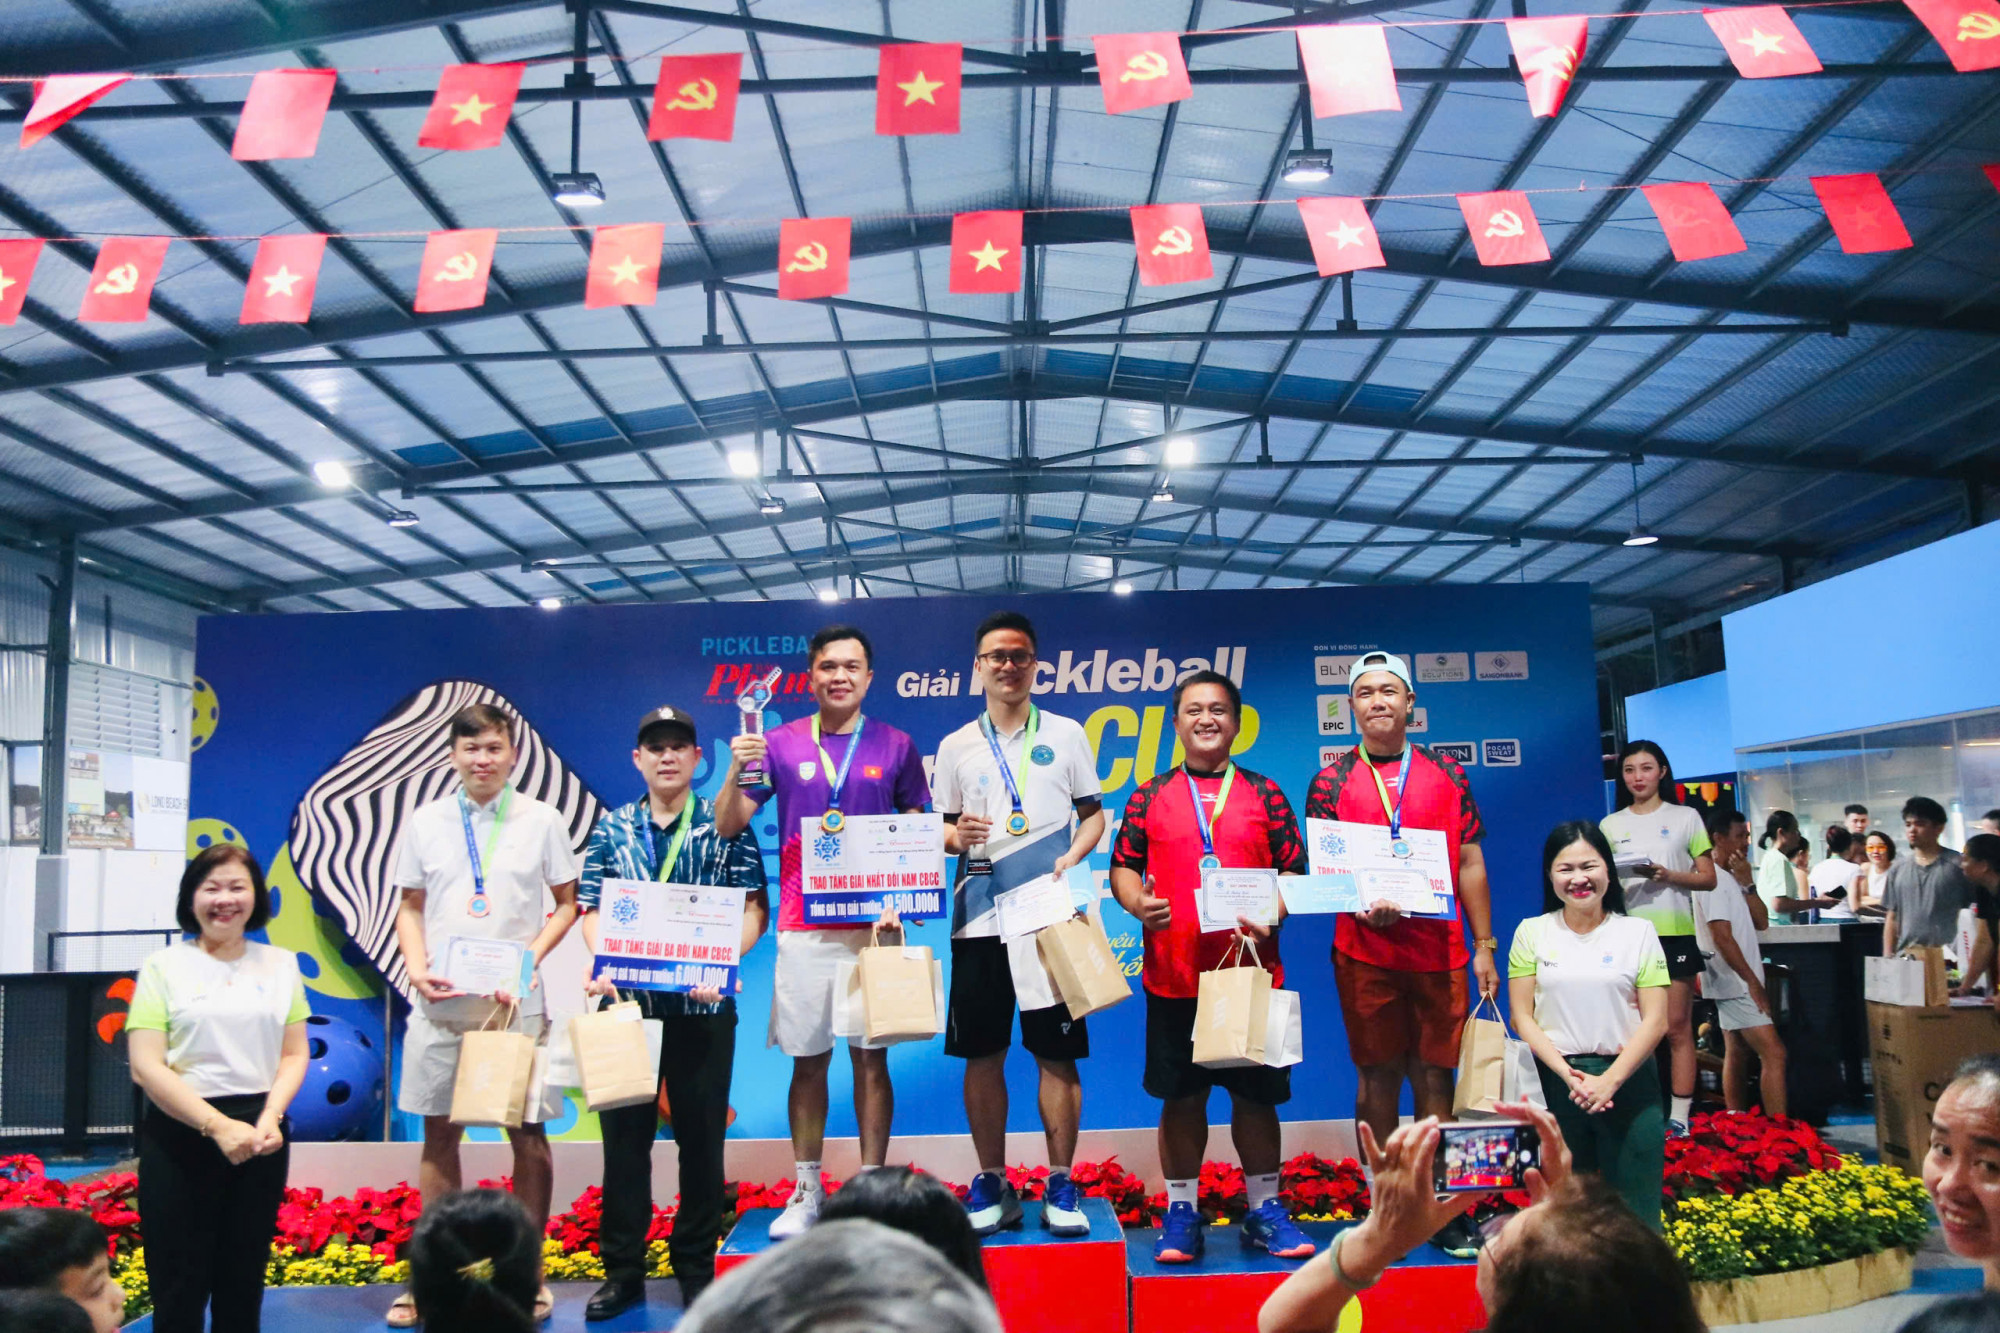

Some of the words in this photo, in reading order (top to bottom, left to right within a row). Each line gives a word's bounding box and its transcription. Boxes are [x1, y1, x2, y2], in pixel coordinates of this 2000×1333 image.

[702, 635, 813, 656] PICKLEBA
[896, 668, 961, 698] Giải
[968, 646, 1247, 696] ckleball
[1323, 722, 1344, 731] EPIC
[809, 875, 827, 890] TRAO
[849, 872, 864, 889] GIẢI
[867, 869, 884, 888] NHẤT
[887, 871, 900, 887] ĐÔI
[902, 873, 917, 887] NAM
[919, 872, 939, 887] CBCC
[1429, 878, 1446, 892] BCC
[826, 902, 837, 916] GIÁ
[604, 938, 623, 953] TRAO
[646, 938, 662, 956] GIẢI
[664, 943, 675, 957] BA
[676, 942, 690, 959] ĐÔI
[692, 945, 708, 960] NAM
[711, 946, 733, 962] CBCC
